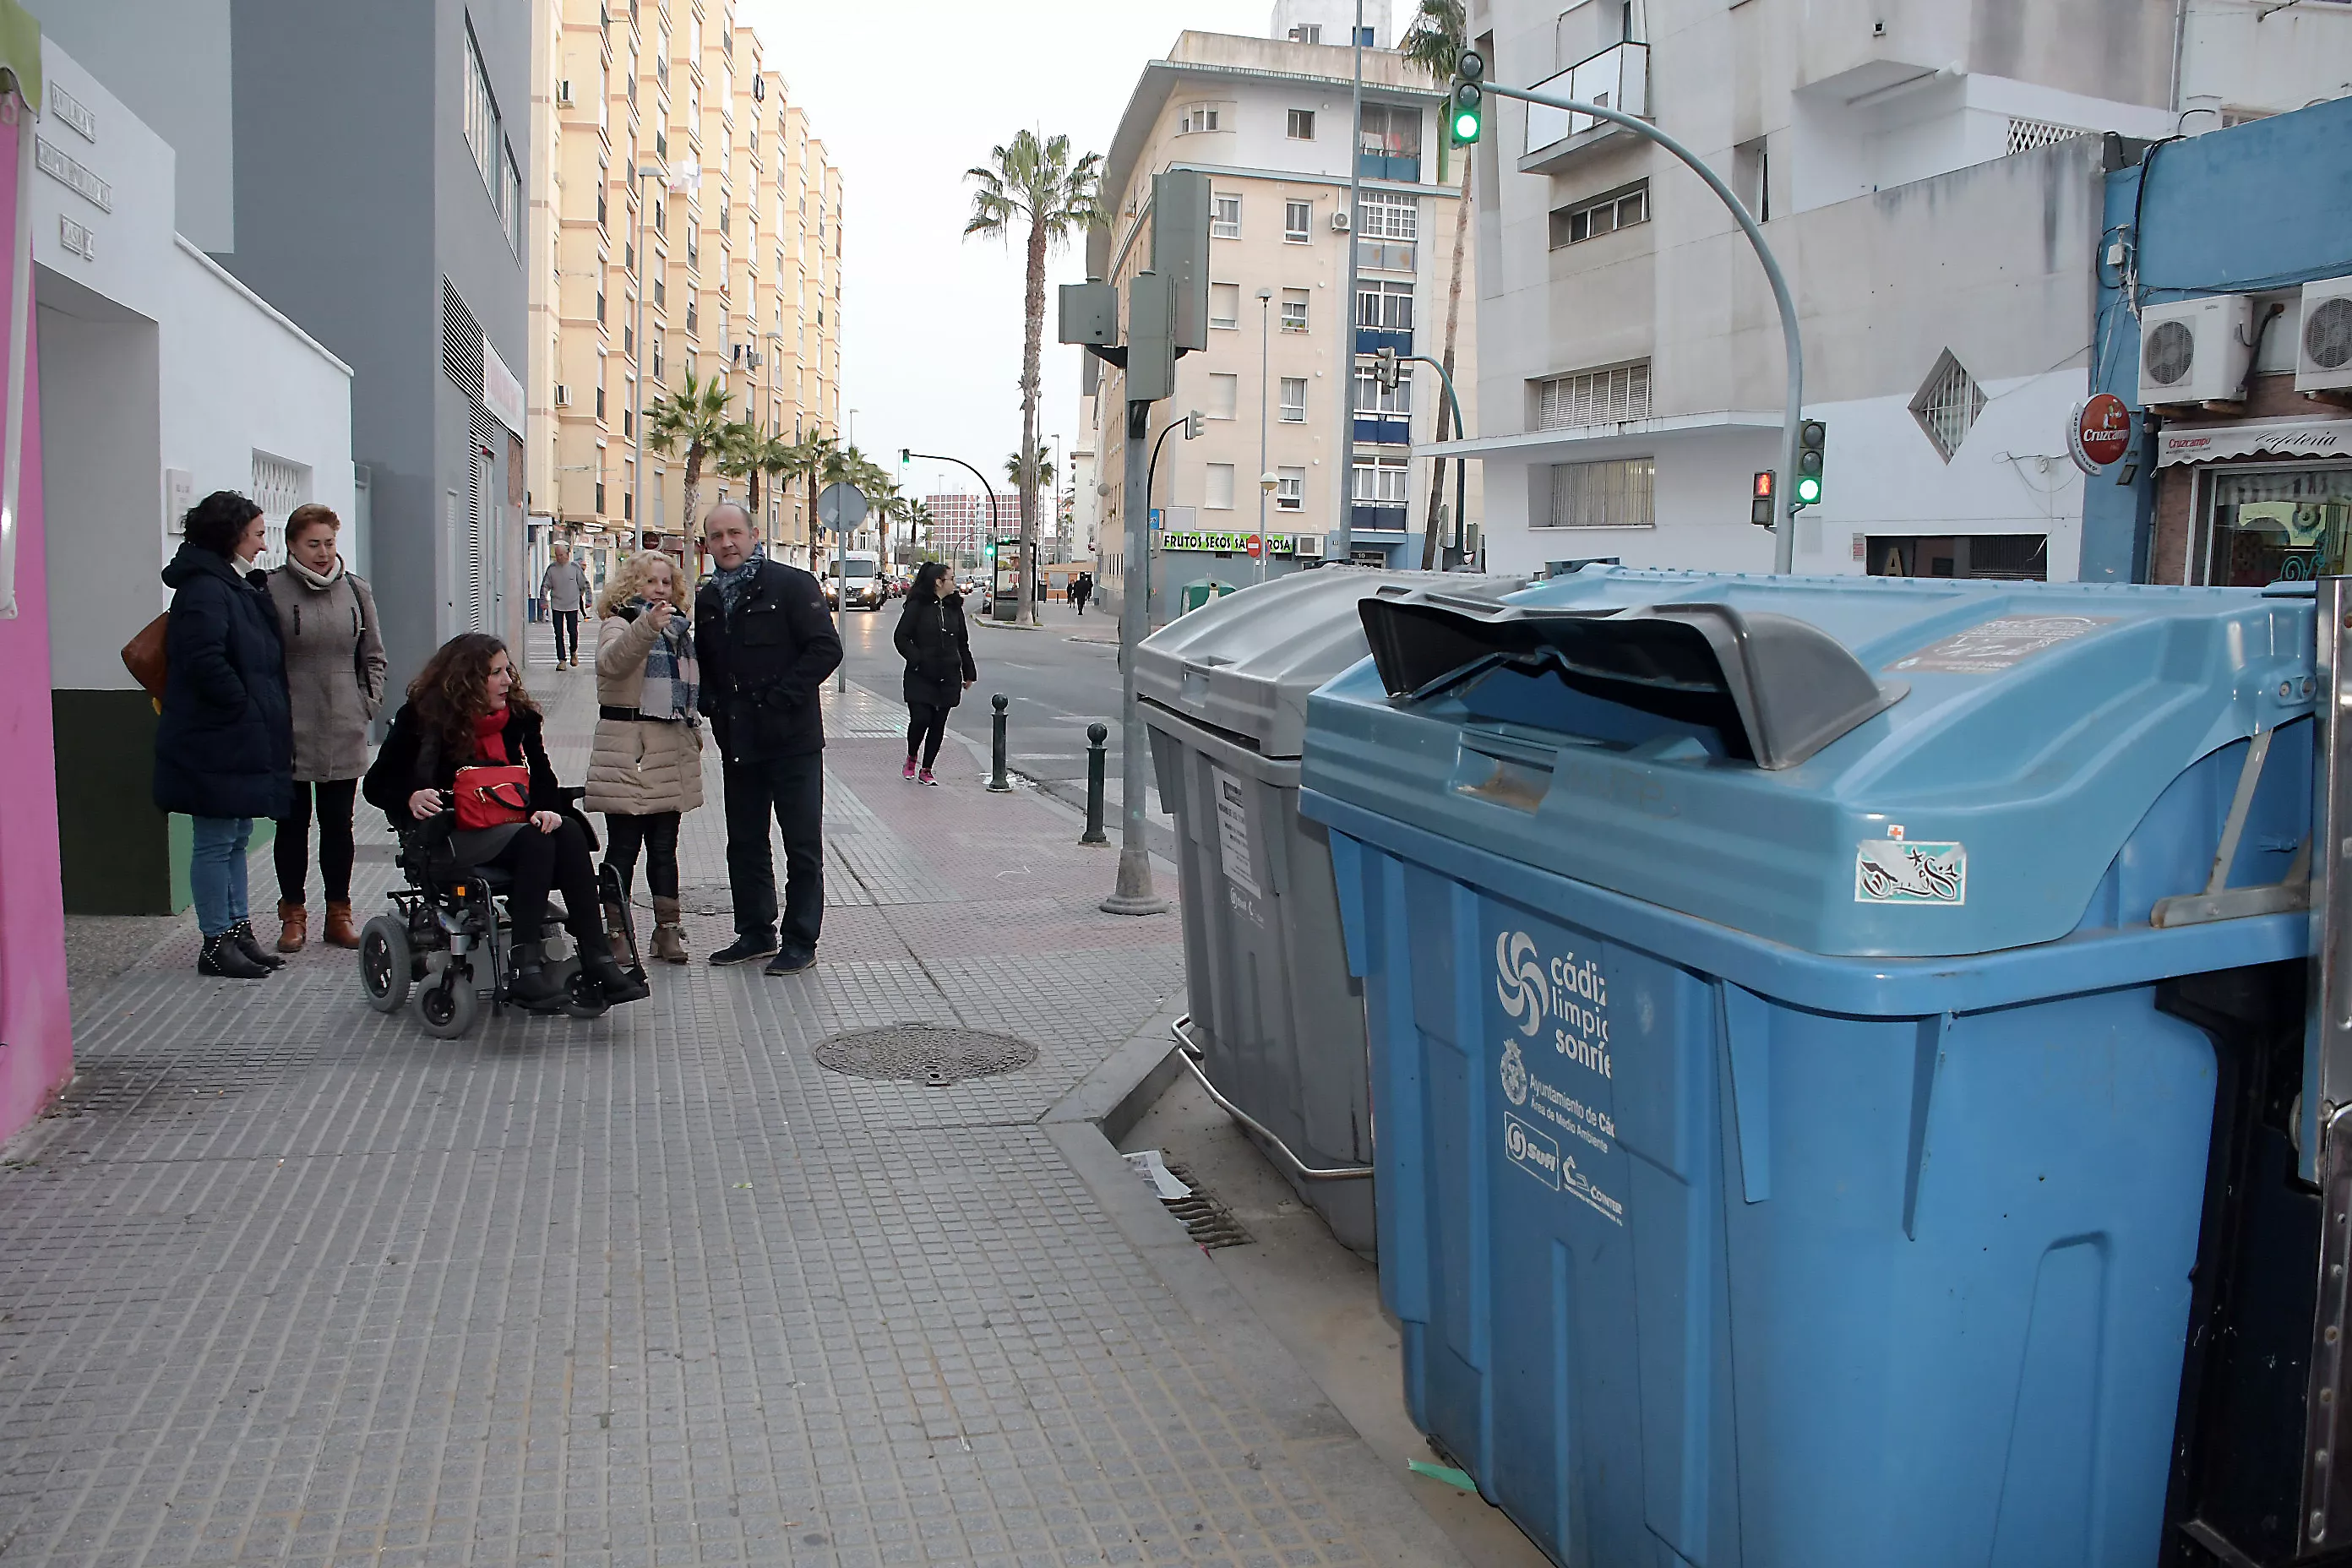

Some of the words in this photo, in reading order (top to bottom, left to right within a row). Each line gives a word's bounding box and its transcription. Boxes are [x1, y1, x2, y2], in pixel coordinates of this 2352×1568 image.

[2169, 438, 2211, 449] Cruzcampo
[1164, 535, 1202, 548] FRUTOS
[1206, 536, 1231, 548] SECOS
[1530, 1073, 1584, 1119] Ayuntamiento
[1586, 1106, 1598, 1126] de
[1546, 1108, 1555, 1122] de
[1555, 1110, 1576, 1135] Medio
[1576, 1124, 1609, 1154] Ambiente
